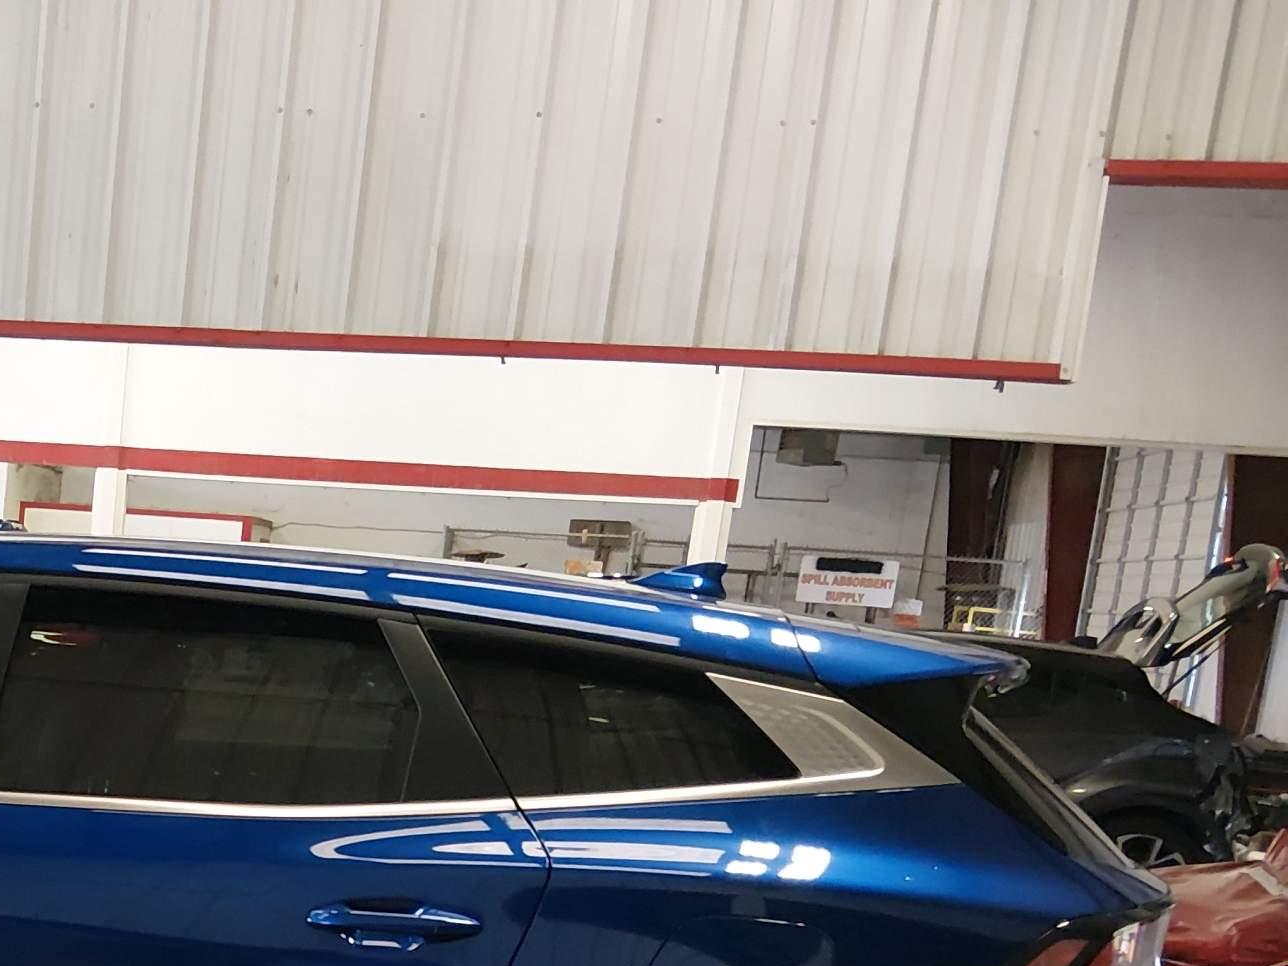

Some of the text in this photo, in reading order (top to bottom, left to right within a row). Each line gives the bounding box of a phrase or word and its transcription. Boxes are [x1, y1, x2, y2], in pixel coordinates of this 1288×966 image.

[801, 573, 894, 590] SPILL ABSORBENT
[825, 591, 864, 603] SUPPLY
